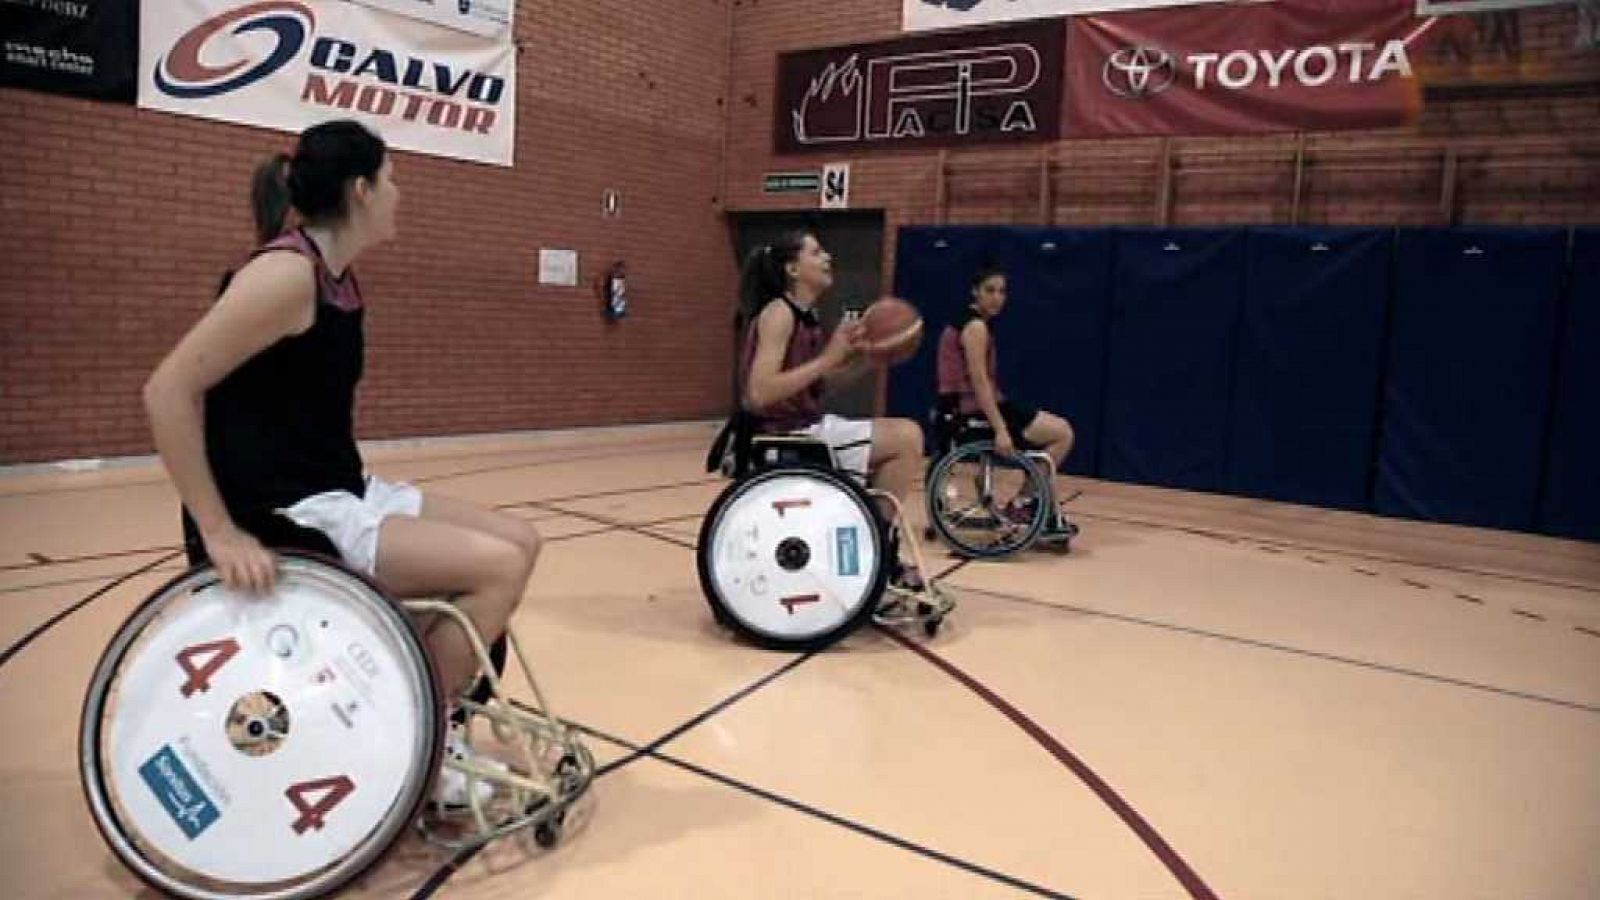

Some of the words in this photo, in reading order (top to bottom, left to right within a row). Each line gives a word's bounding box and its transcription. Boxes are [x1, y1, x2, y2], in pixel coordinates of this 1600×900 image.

[1187, 39, 1413, 90] TOYOTA
[302, 73, 497, 134] MOTOR
[772, 499, 812, 517] 1
[779, 594, 820, 615] 1
[175, 637, 241, 699] 4
[284, 775, 356, 835] 4
